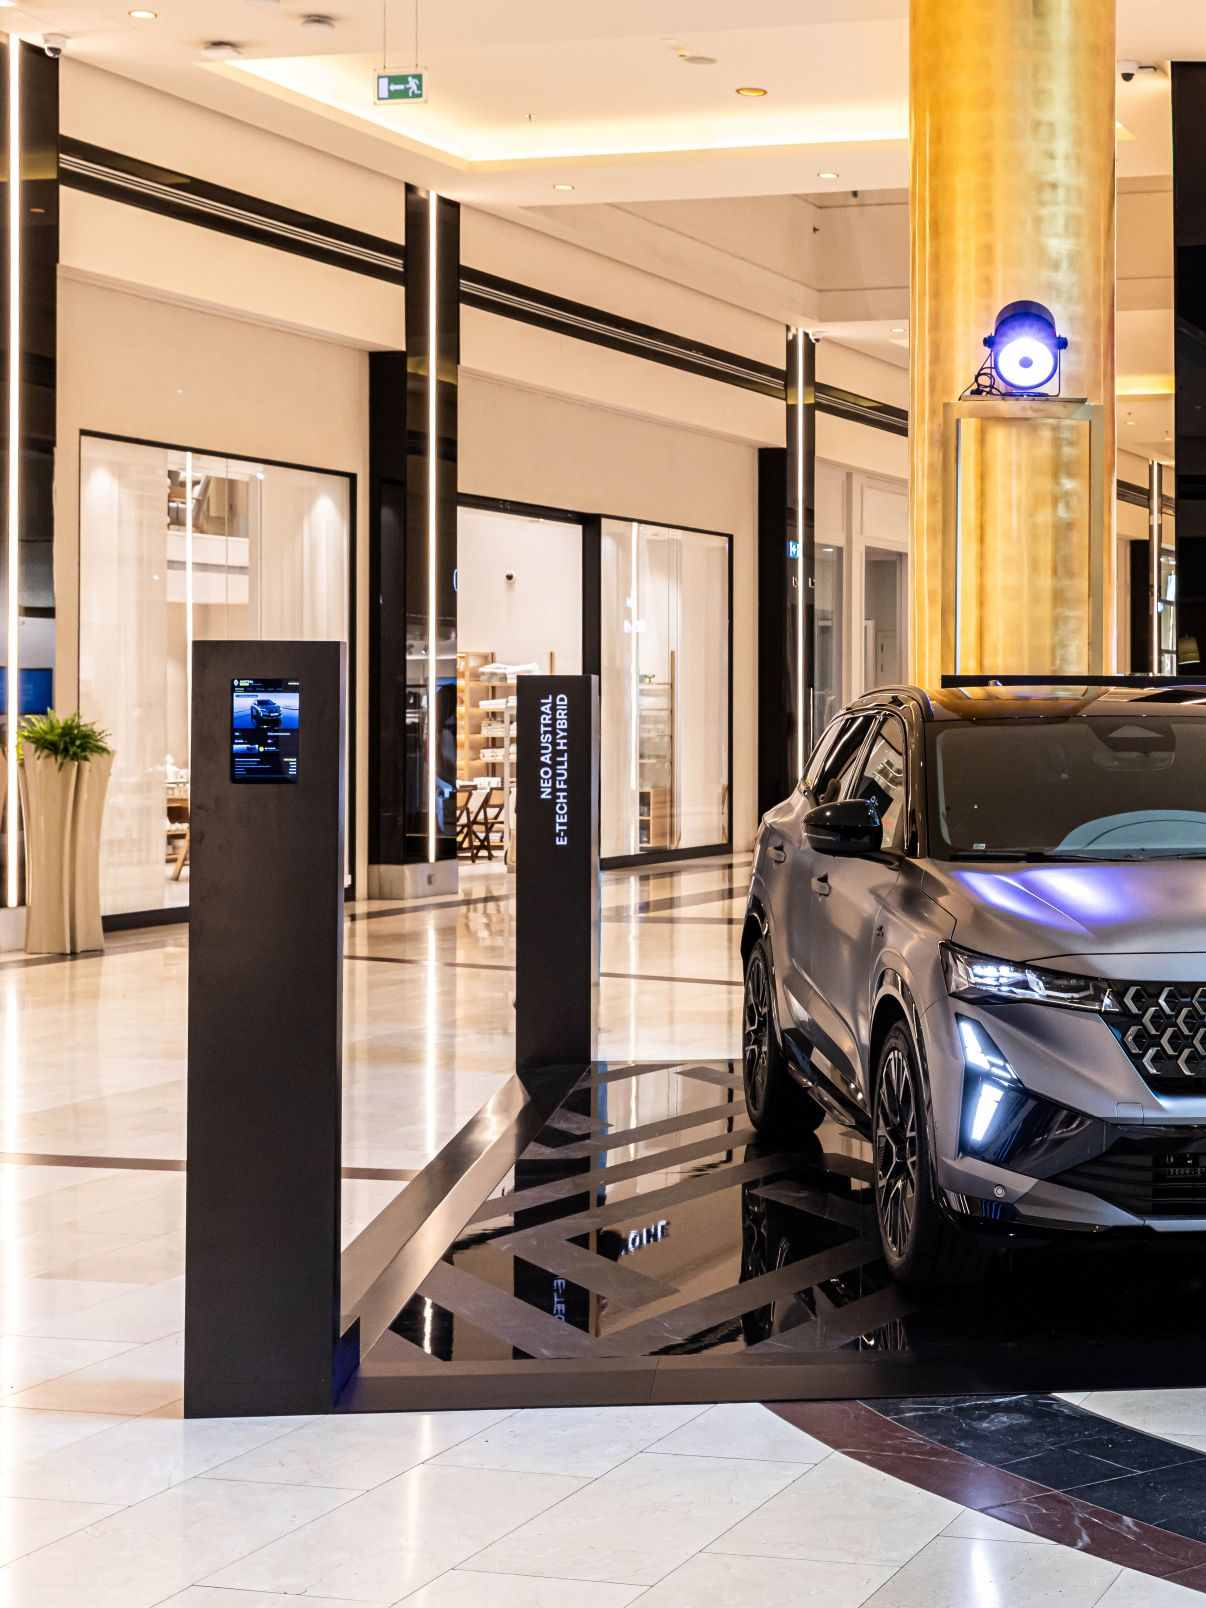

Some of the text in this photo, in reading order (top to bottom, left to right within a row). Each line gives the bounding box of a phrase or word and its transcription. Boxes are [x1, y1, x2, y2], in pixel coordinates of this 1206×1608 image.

[540, 694, 552, 799] NEO AUSTRAL
[556, 694, 568, 846] E-TECH FULL HYBRID
